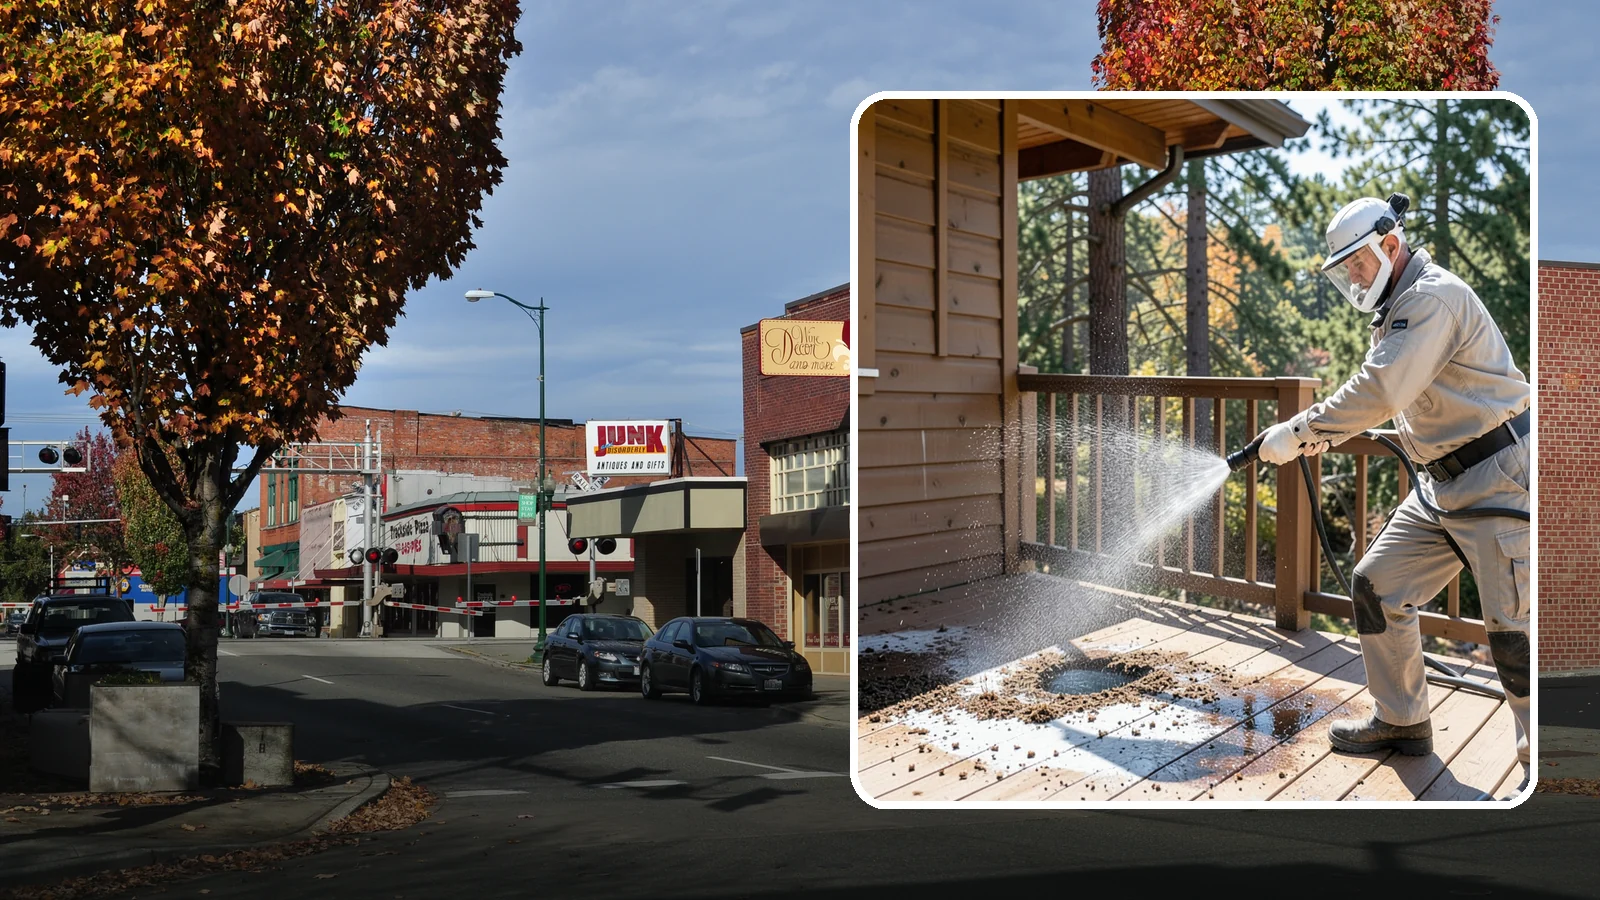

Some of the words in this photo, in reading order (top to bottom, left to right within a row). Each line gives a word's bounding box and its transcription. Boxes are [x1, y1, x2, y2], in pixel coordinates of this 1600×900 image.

[764, 327, 831, 365] Decor
[595, 425, 664, 457] JUNK
[607, 445, 646, 454] DISORDERLY
[596, 461, 628, 470] ANTIQUES
[631, 461, 644, 470] AND
[647, 460, 666, 469] GIFTS
[573, 473, 589, 492] RAIL
[590, 476, 608, 491] SING
[390, 521, 413, 539] Trackside
[414, 519, 429, 534] Pizza
